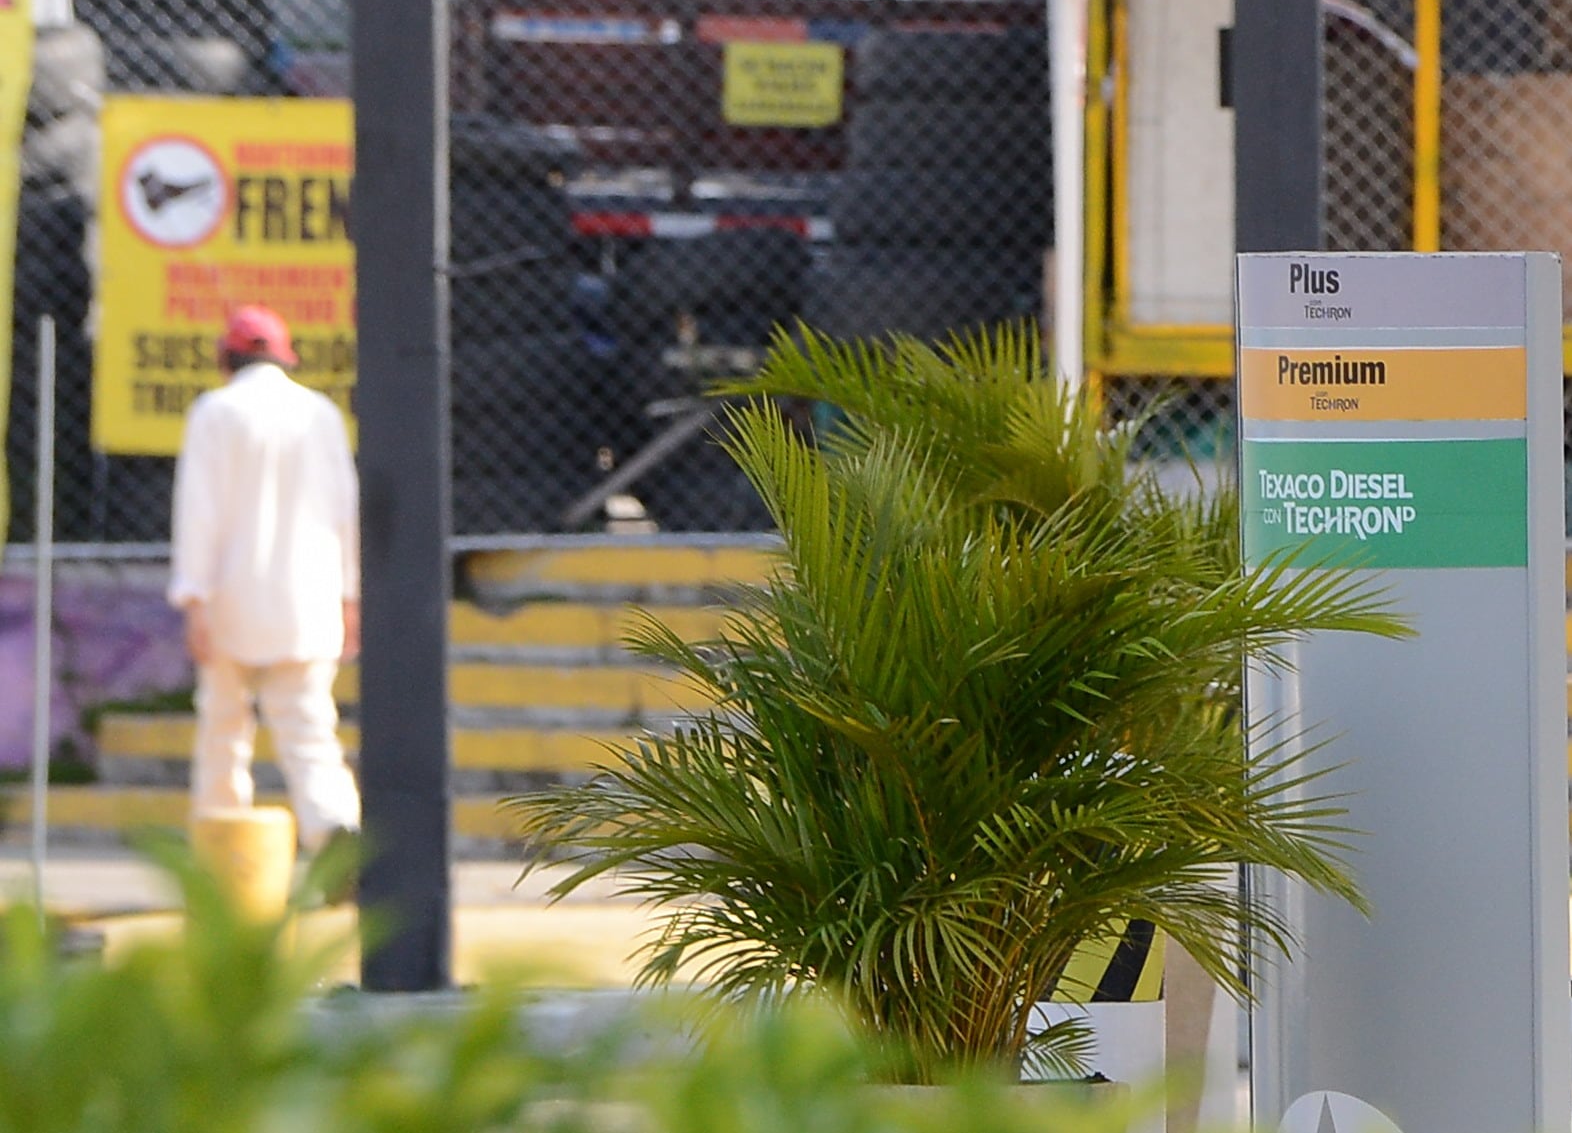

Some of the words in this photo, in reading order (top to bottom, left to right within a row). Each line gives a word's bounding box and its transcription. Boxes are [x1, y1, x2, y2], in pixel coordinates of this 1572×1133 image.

[1289, 263, 1341, 295] Plus
[1304, 304, 1352, 321] TECHRON
[1278, 355, 1386, 385] Premium
[1309, 396, 1359, 412] TECHRON
[1258, 469, 1325, 500] TEXACO
[1329, 469, 1414, 500] DIESEL
